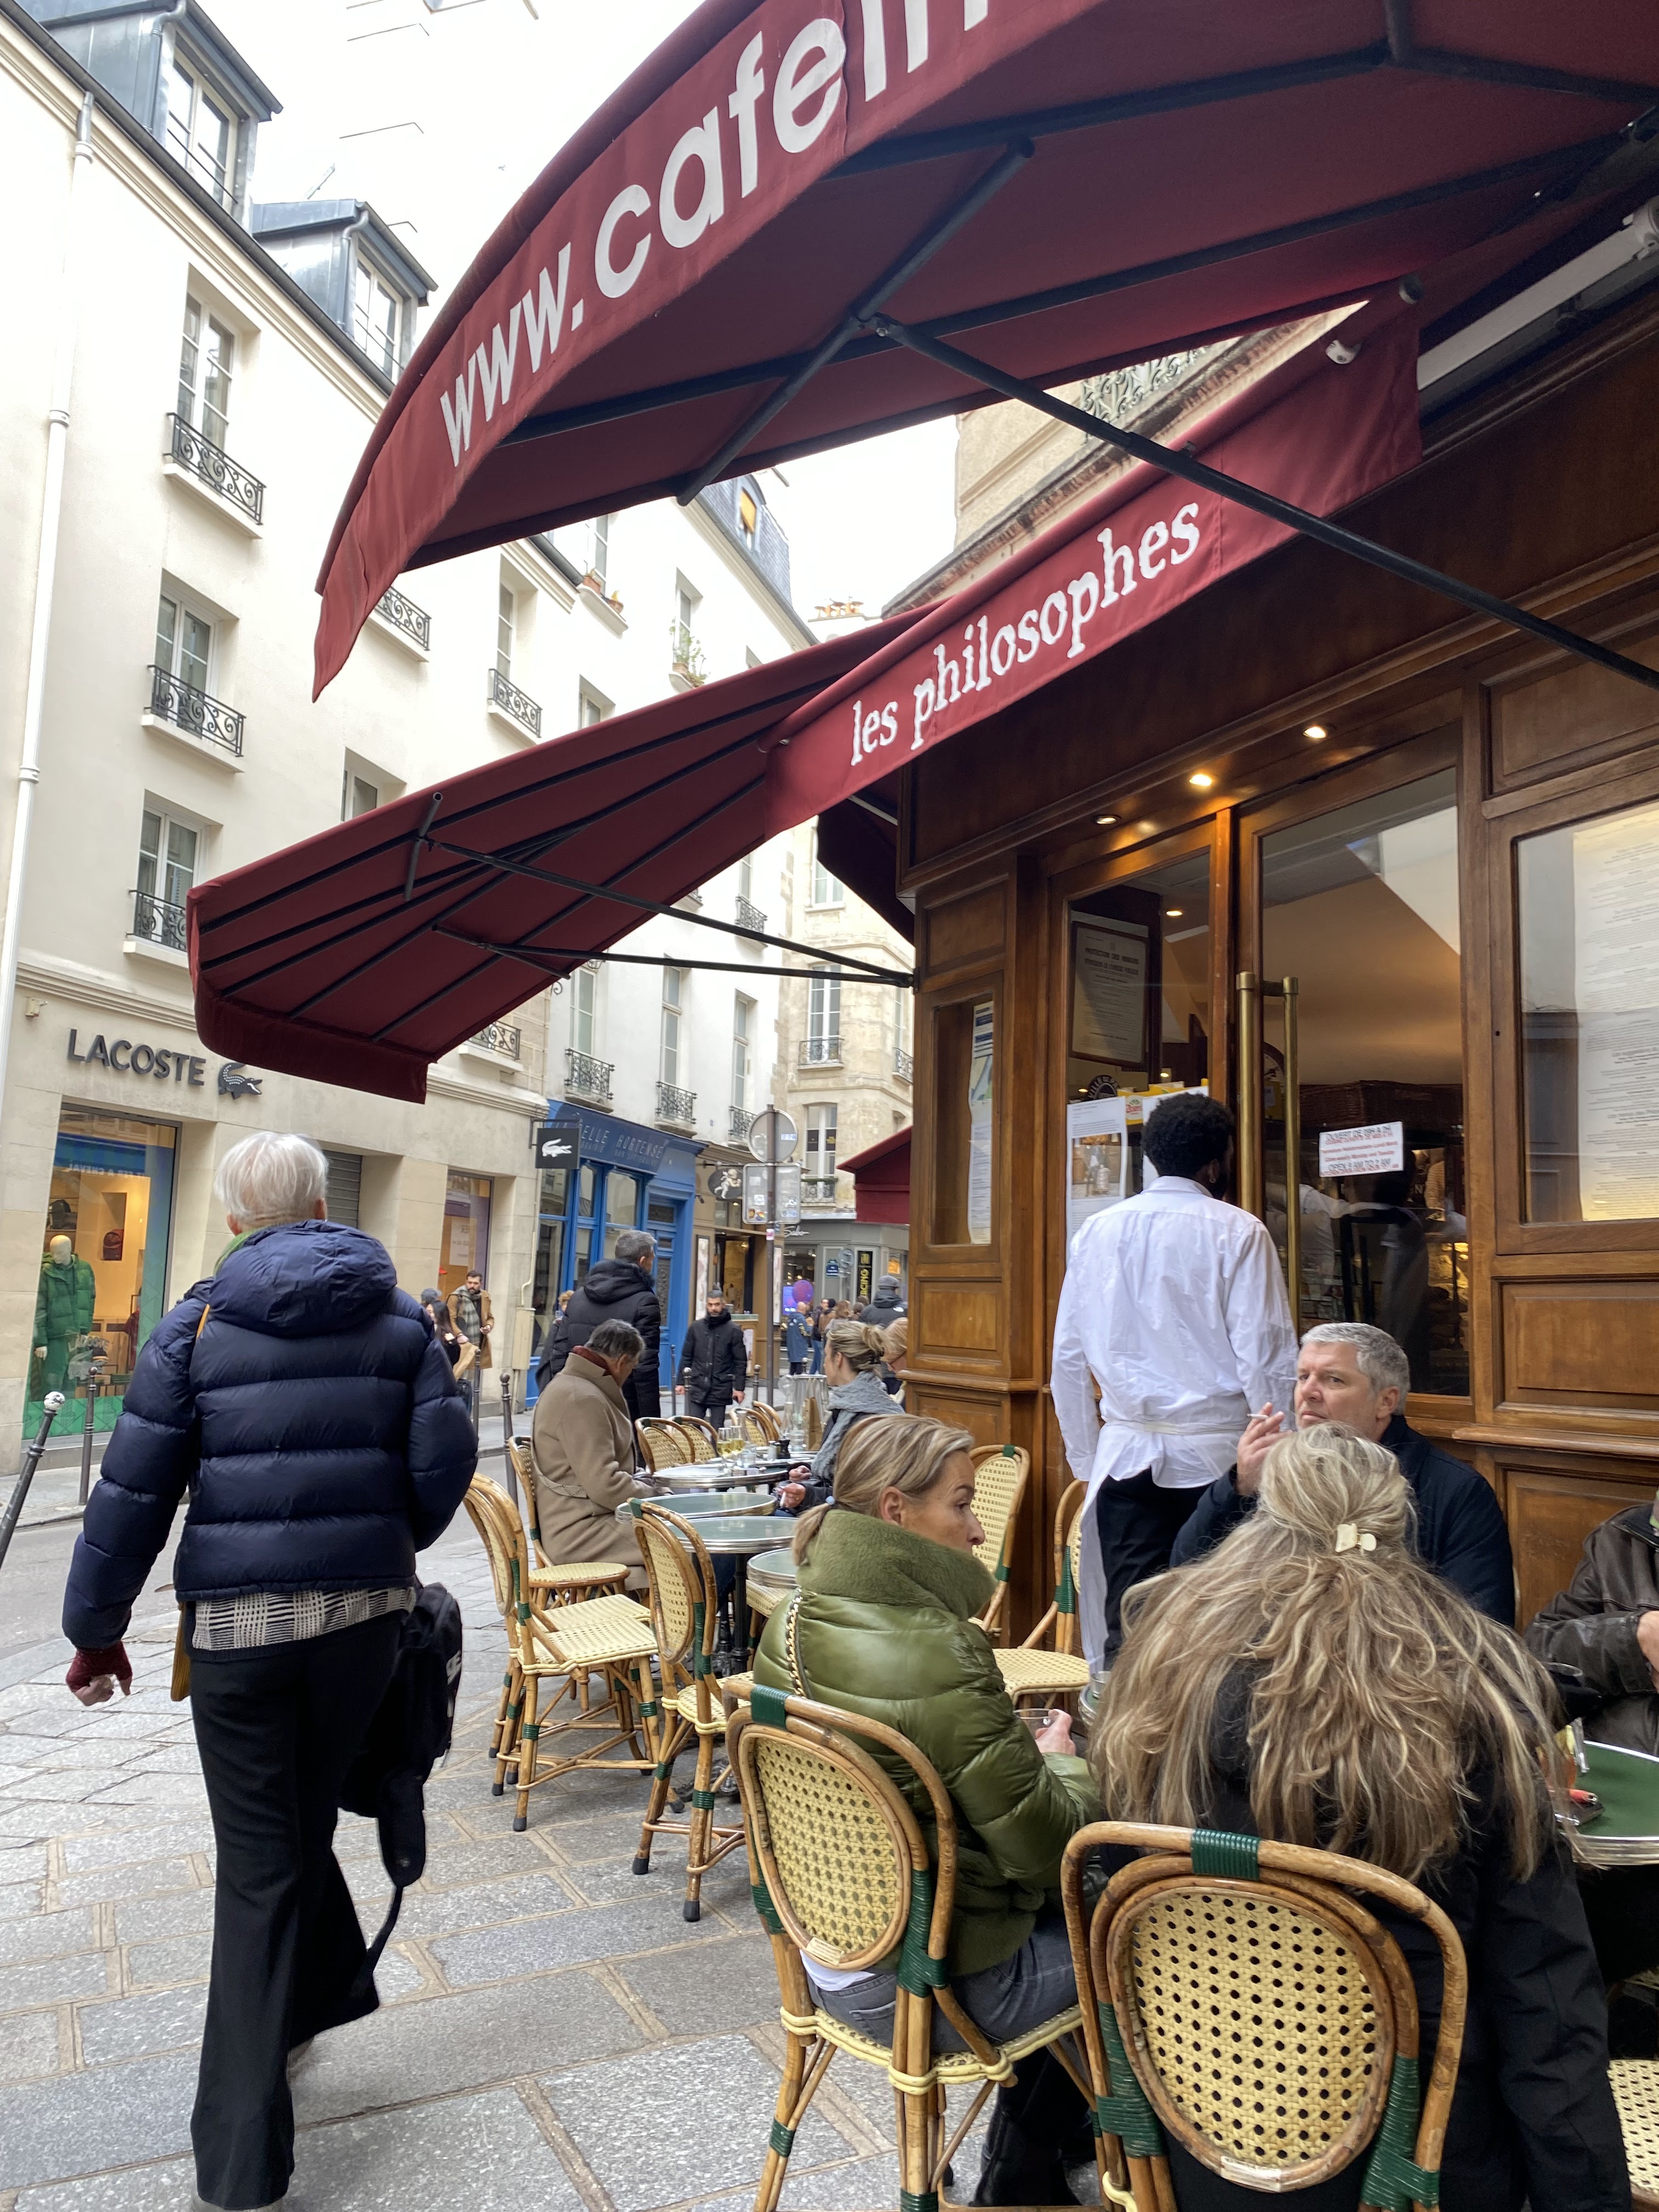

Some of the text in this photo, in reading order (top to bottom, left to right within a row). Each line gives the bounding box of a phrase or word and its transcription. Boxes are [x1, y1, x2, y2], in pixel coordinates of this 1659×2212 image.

[439, 0, 988, 467] www.cafe
[850, 502, 1201, 766] les philosophes
[68, 1029, 206, 1086] LACOSTE
[1088, 1076, 1103, 1098] VILLE
[616, 1133, 664, 1159] HORTENSE
[860, 1268, 869, 1297] RCING
